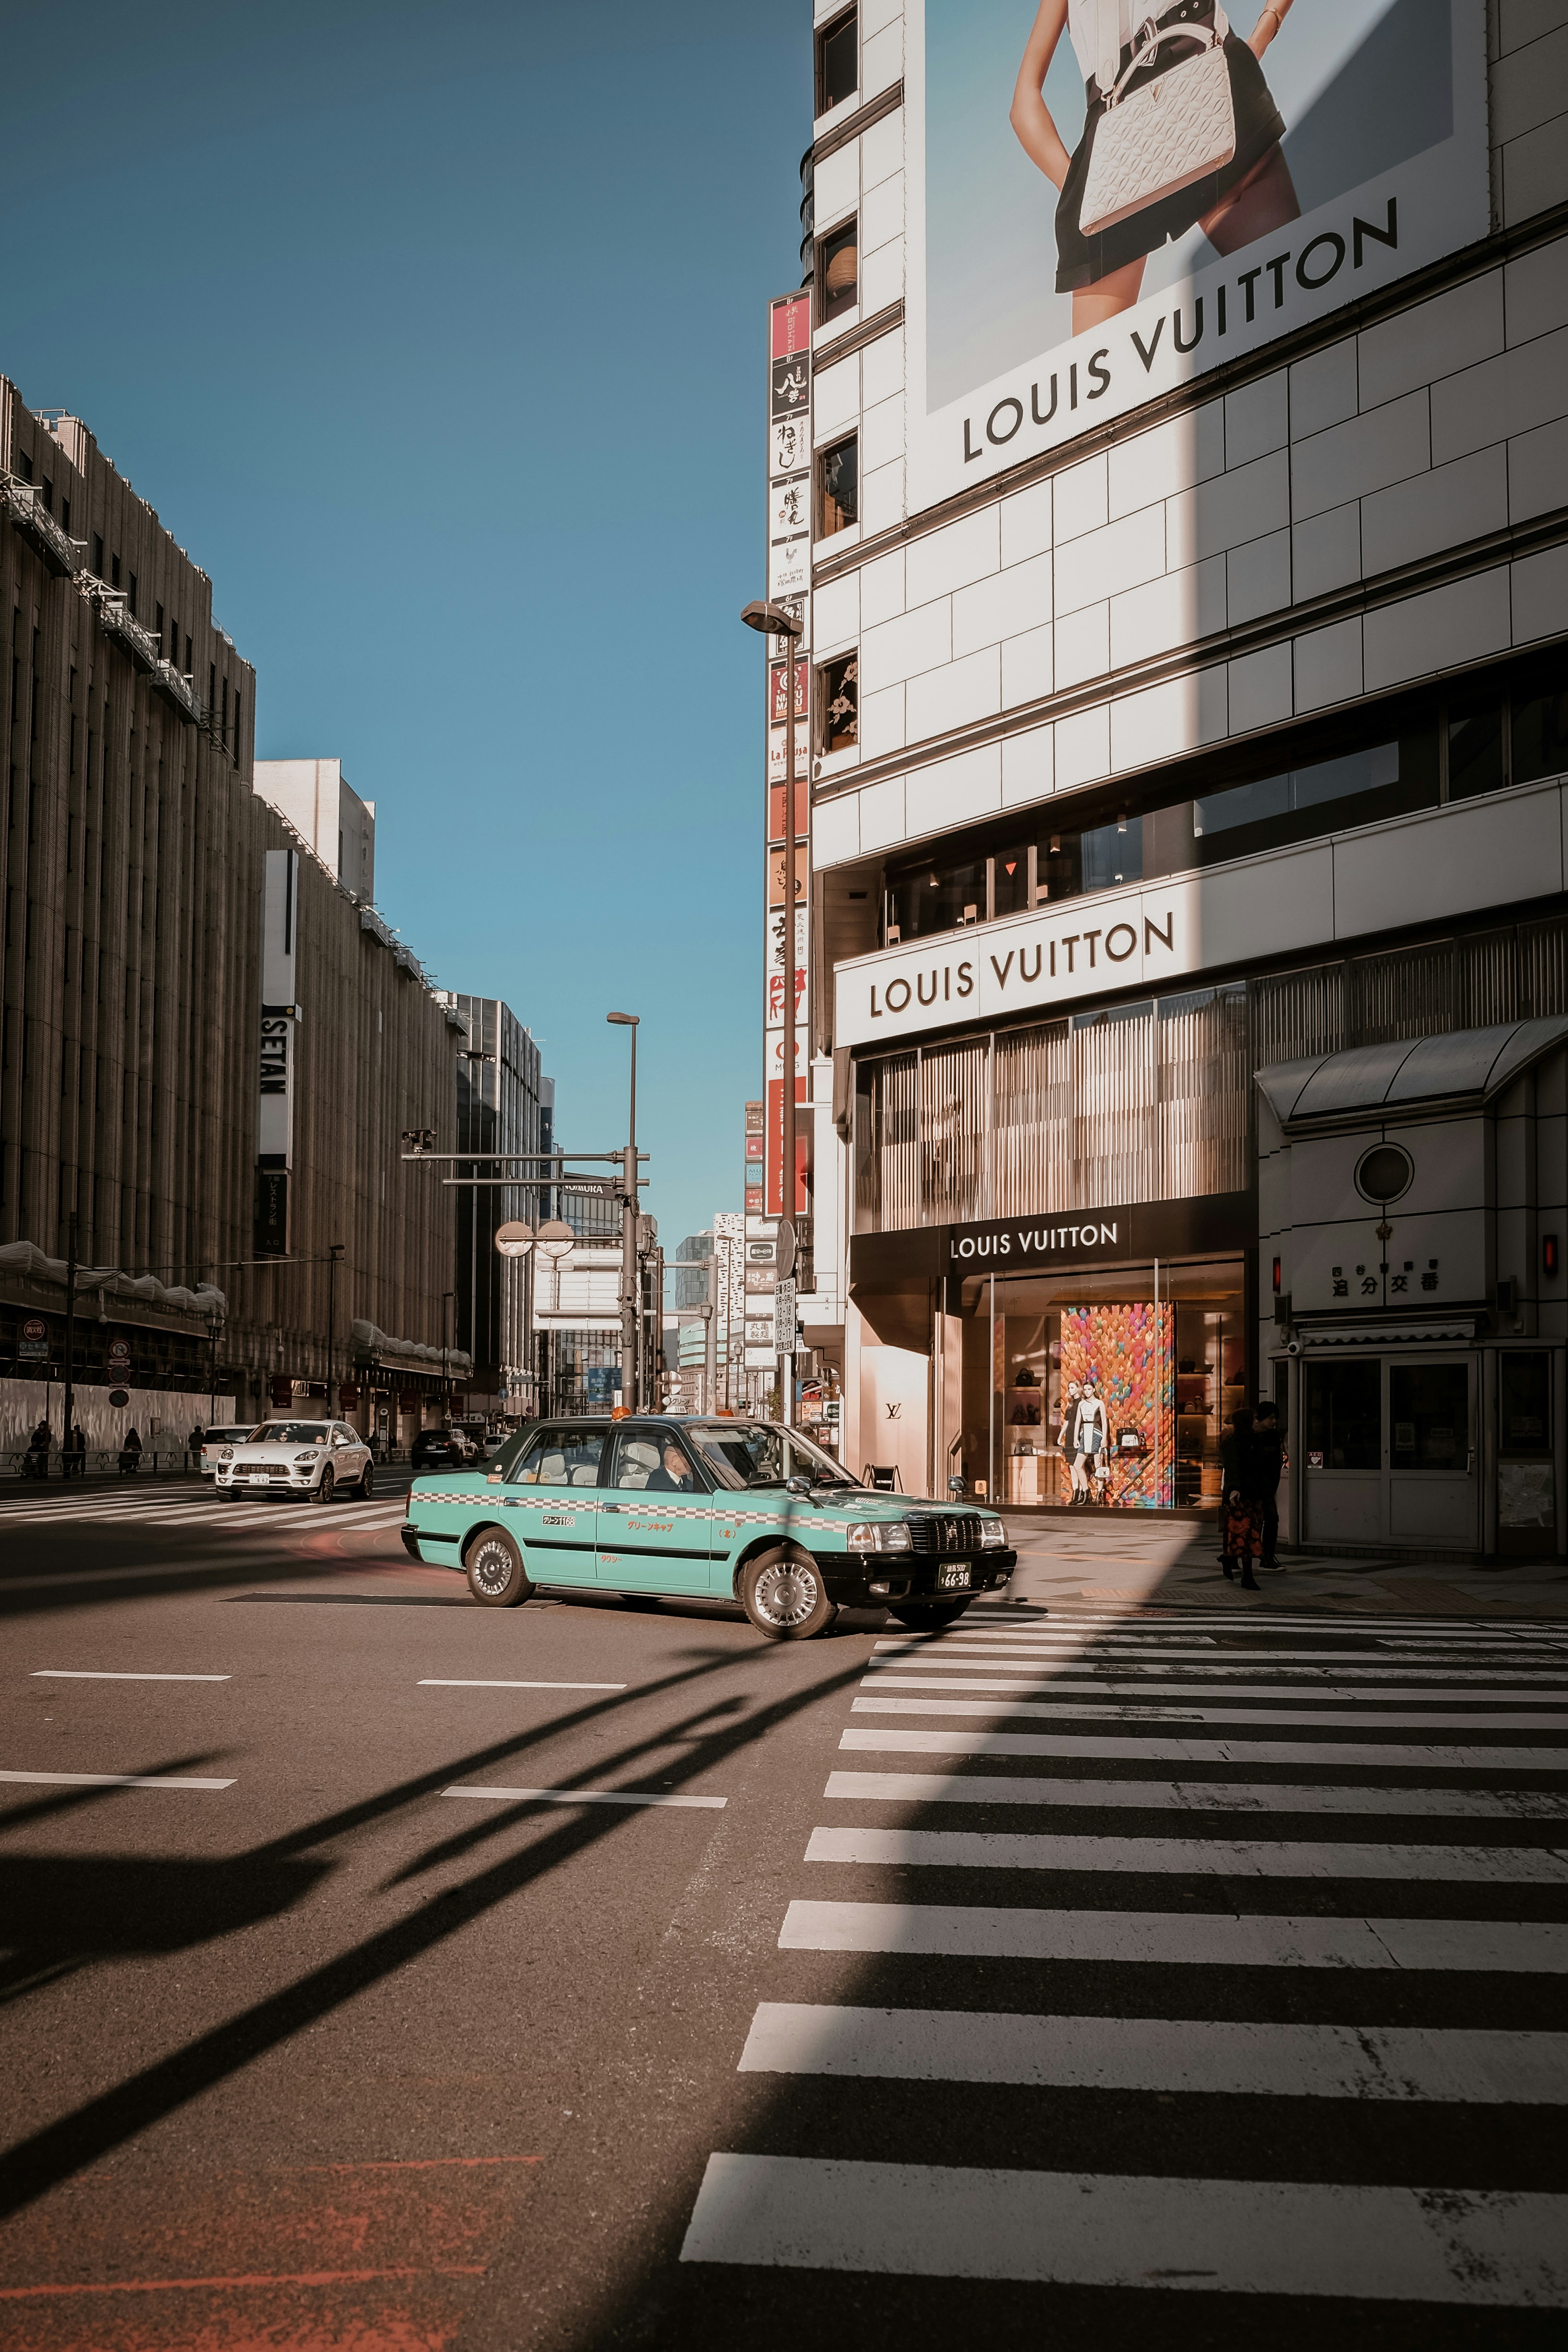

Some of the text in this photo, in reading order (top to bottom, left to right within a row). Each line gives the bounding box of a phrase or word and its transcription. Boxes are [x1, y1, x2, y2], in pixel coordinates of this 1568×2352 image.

[964, 197, 1397, 463] LOUIS VUITTON
[777, 424, 796, 469] ねぎし
[771, 750, 781, 761] La
[870, 911, 1174, 1018] LOUIS VUITTON
[269, 1182, 277, 1225] レストラン街
[951, 1223, 1117, 1259] LOUIS VUITTON
[1332, 1272, 1438, 1297] 追分交番
[749, 1322, 769, 1331] 丸亀
[600, 1555, 623, 1563] タクシー
[944, 1572, 969, 1587] 66-98
